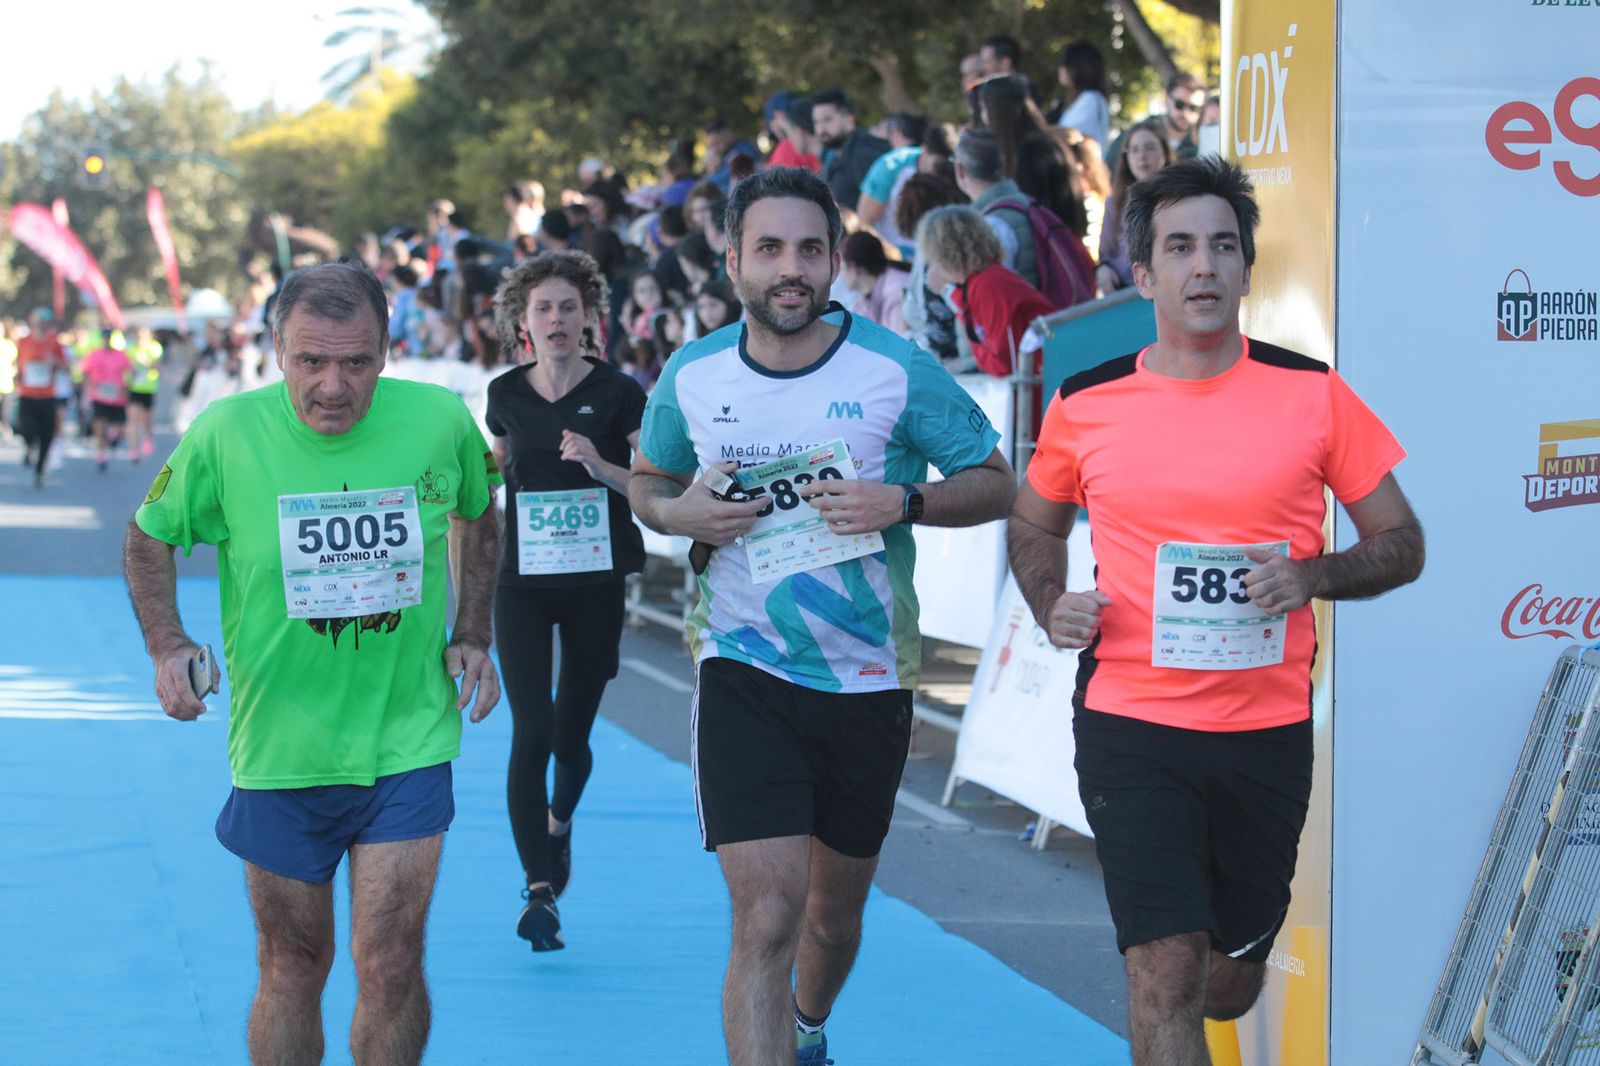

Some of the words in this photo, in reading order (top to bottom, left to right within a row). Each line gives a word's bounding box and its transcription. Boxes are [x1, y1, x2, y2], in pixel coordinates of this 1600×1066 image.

[1234, 51, 1289, 157] CDX
[1540, 288, 1597, 315] AARÓN
[1540, 318, 1598, 341] PIEDRA
[721, 443, 770, 459] Medio
[1546, 456, 1598, 476] MONT
[1527, 474, 1600, 503] DEPOR
[529, 504, 600, 532] 5469
[298, 511, 408, 554] 5005
[319, 551, 370, 564] ANTONIO
[373, 550, 389, 559] LR
[1171, 566, 1252, 604] 583
